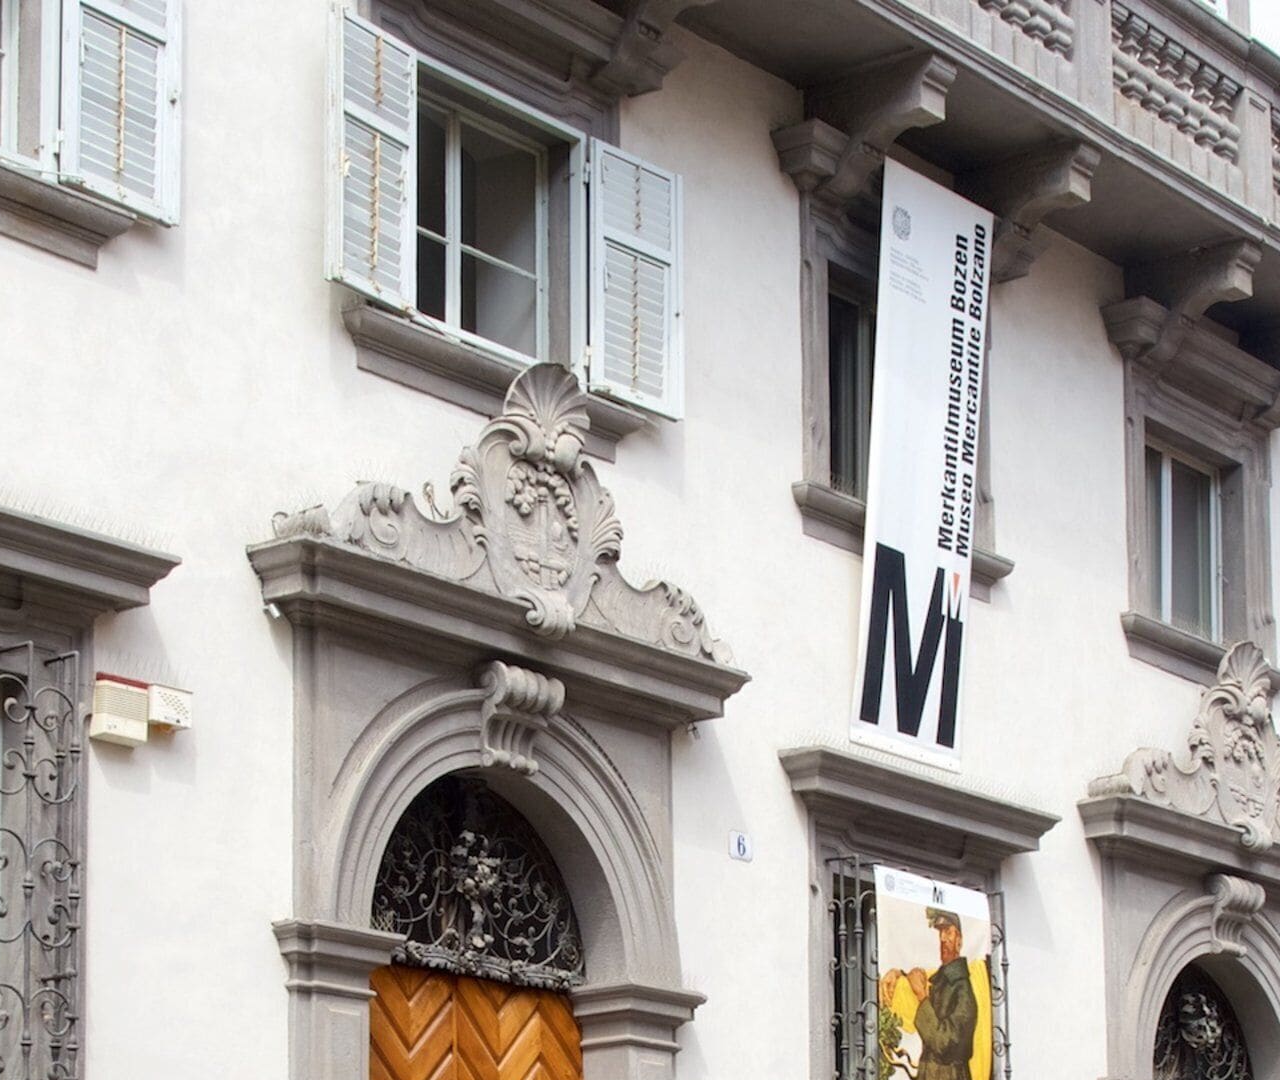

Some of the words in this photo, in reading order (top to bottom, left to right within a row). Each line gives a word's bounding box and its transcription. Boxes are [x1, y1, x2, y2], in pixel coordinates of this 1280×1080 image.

[950, 233, 969, 314] Bozen
[969, 223, 986, 322] Bolzano
[937, 317, 966, 551] Merkantilmuseum
[961, 327, 981, 466] Mercantile
[956, 471, 973, 558] Museo
[737, 834, 746, 857] 6
